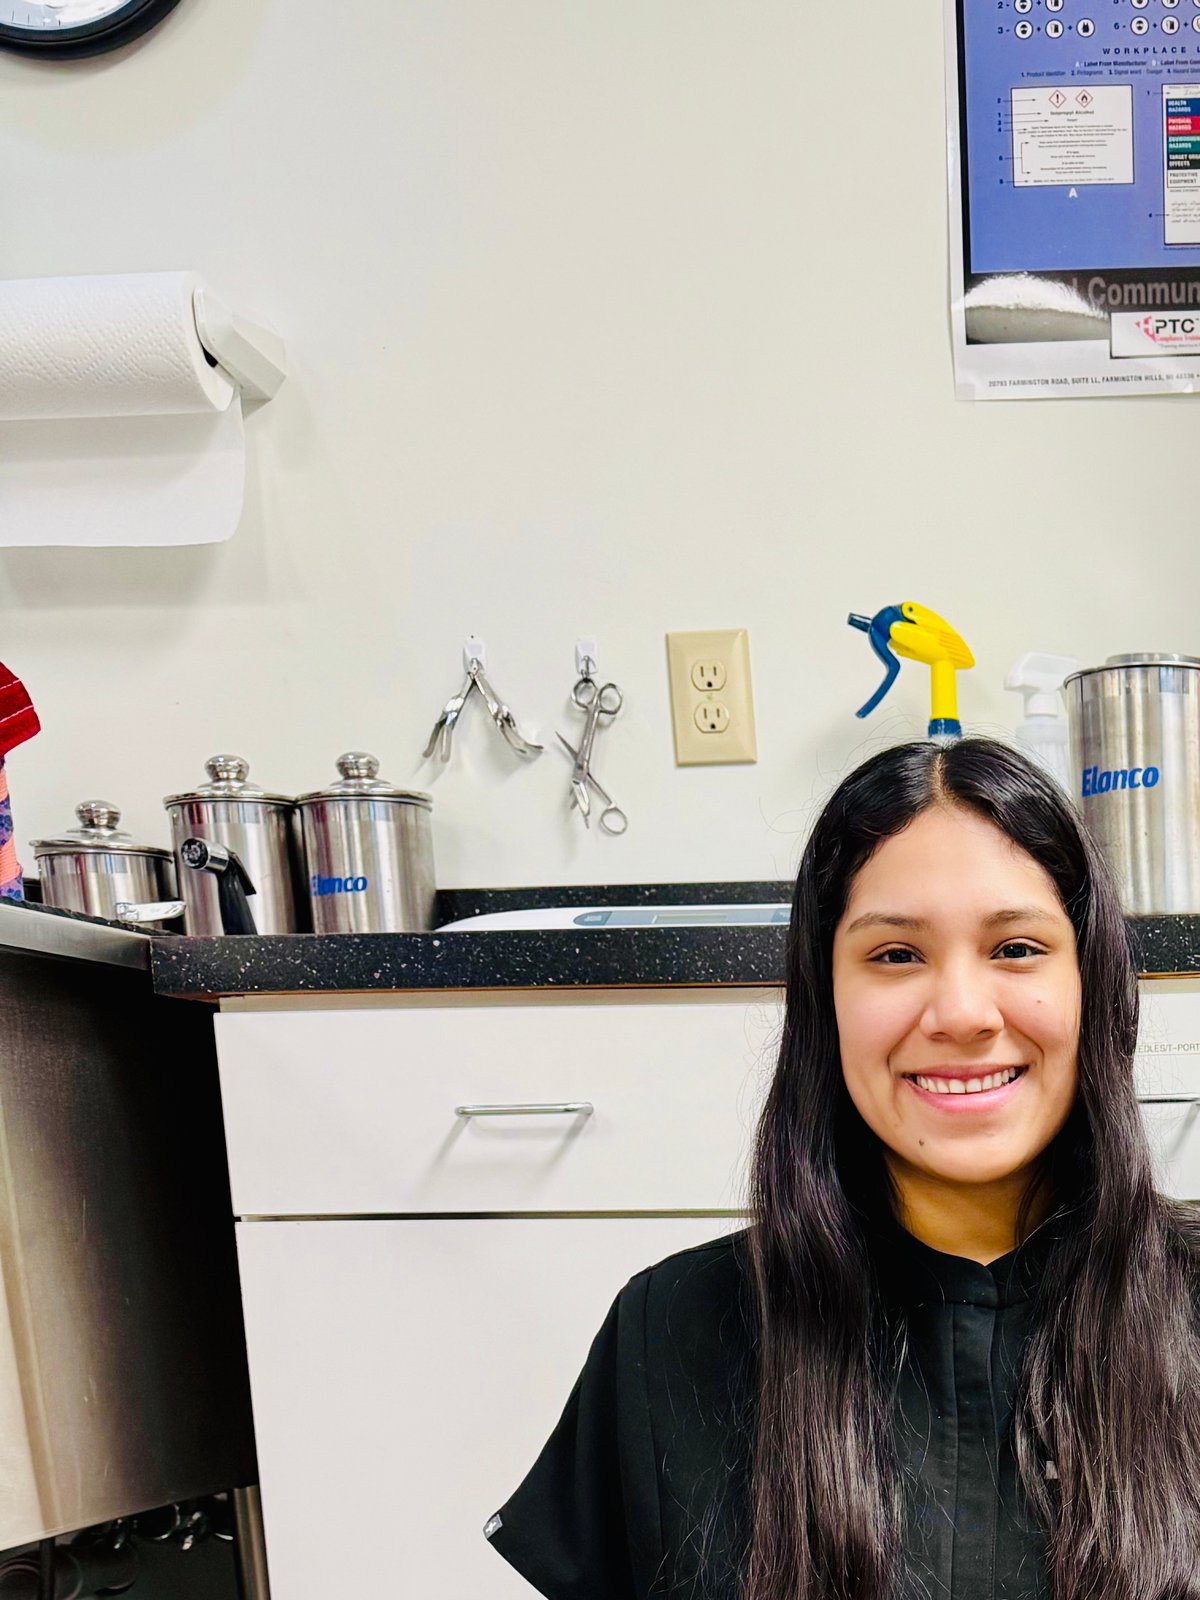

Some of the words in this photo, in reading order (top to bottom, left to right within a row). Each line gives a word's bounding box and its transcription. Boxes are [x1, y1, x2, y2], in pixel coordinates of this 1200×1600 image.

[1102, 46, 1186, 55] WORKPLACE
[1069, 187, 1078, 198] A
[1009, 379, 1049, 387] FARMINGTON
[1051, 377, 1070, 385] ROAD,
[1071, 377, 1089, 385] SUITE
[1102, 375, 1143, 383] FARMINGTON
[1145, 374, 1165, 382] HILLS,
[1082, 766, 1160, 798] Elanco
